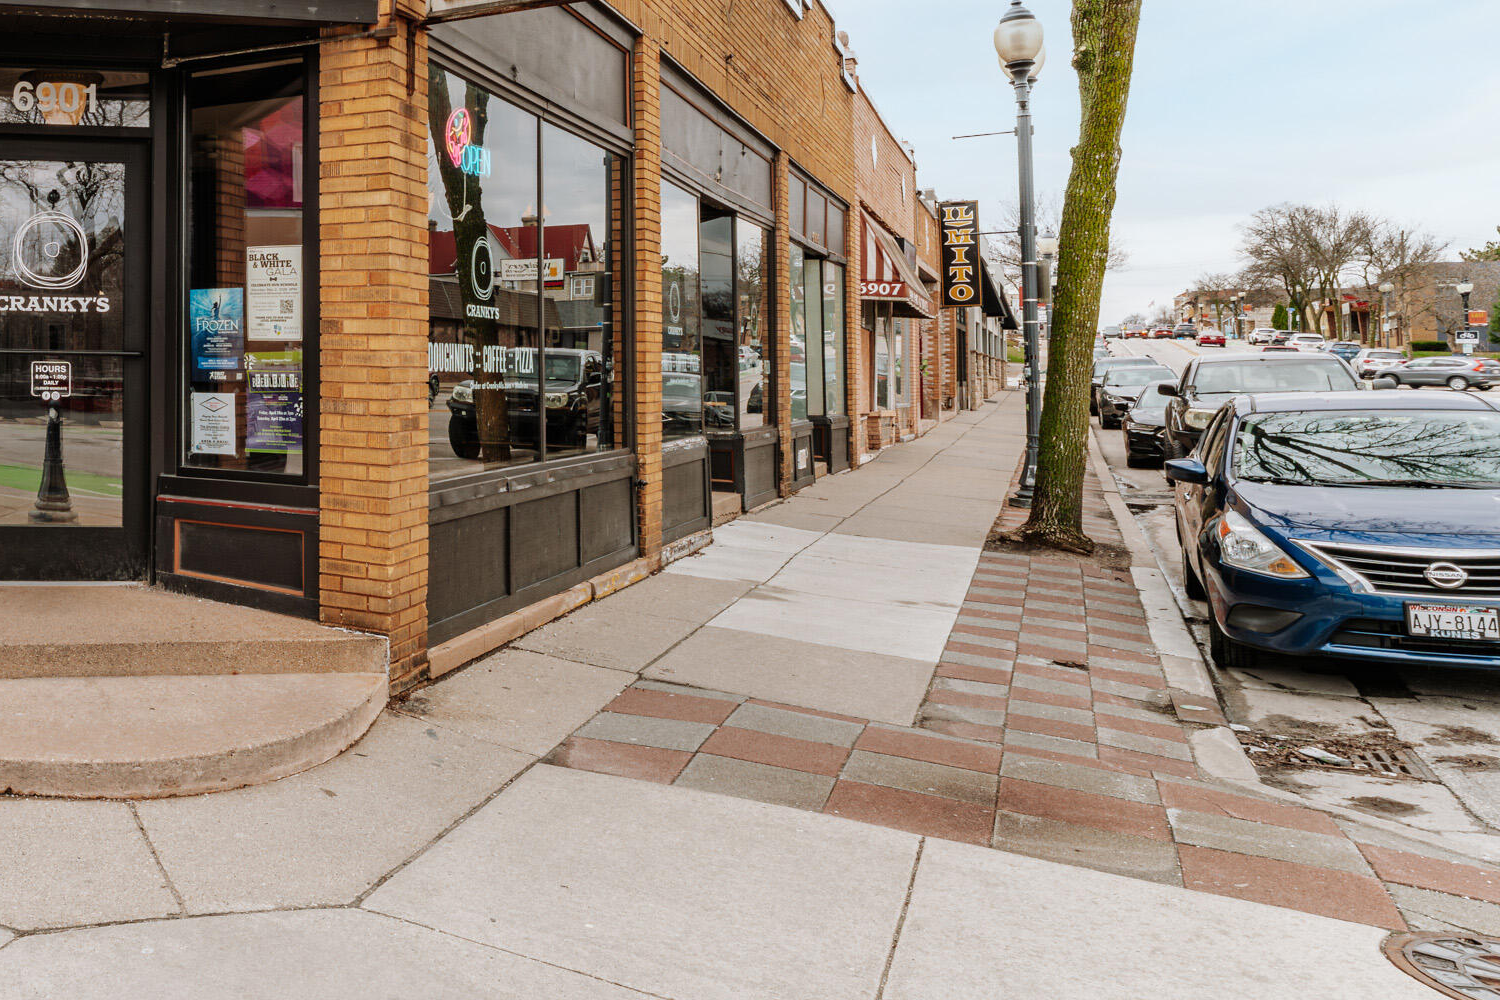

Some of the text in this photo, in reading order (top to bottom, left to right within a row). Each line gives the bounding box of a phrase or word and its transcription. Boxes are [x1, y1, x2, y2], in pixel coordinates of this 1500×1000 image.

[13, 81, 97, 113] 6901
[462, 145, 491, 177] OPEN
[248, 253, 279, 261] BLACK
[942, 205, 975, 301] IL MITO
[260, 260, 292, 268] WHITE
[265, 267, 297, 276] GALA
[196, 317, 239, 334] FROZEN
[428, 341, 474, 373] DOUGHNUTS
[483, 345, 507, 373] COFFEE
[515, 347, 534, 374] PIZZA
[252, 373, 299, 388] BEETLEJUICE
[1409, 604, 1458, 612] WISCONSIN
[1413, 613, 1498, 632] AJY-8144
[1430, 629, 1481, 639] KUNES
